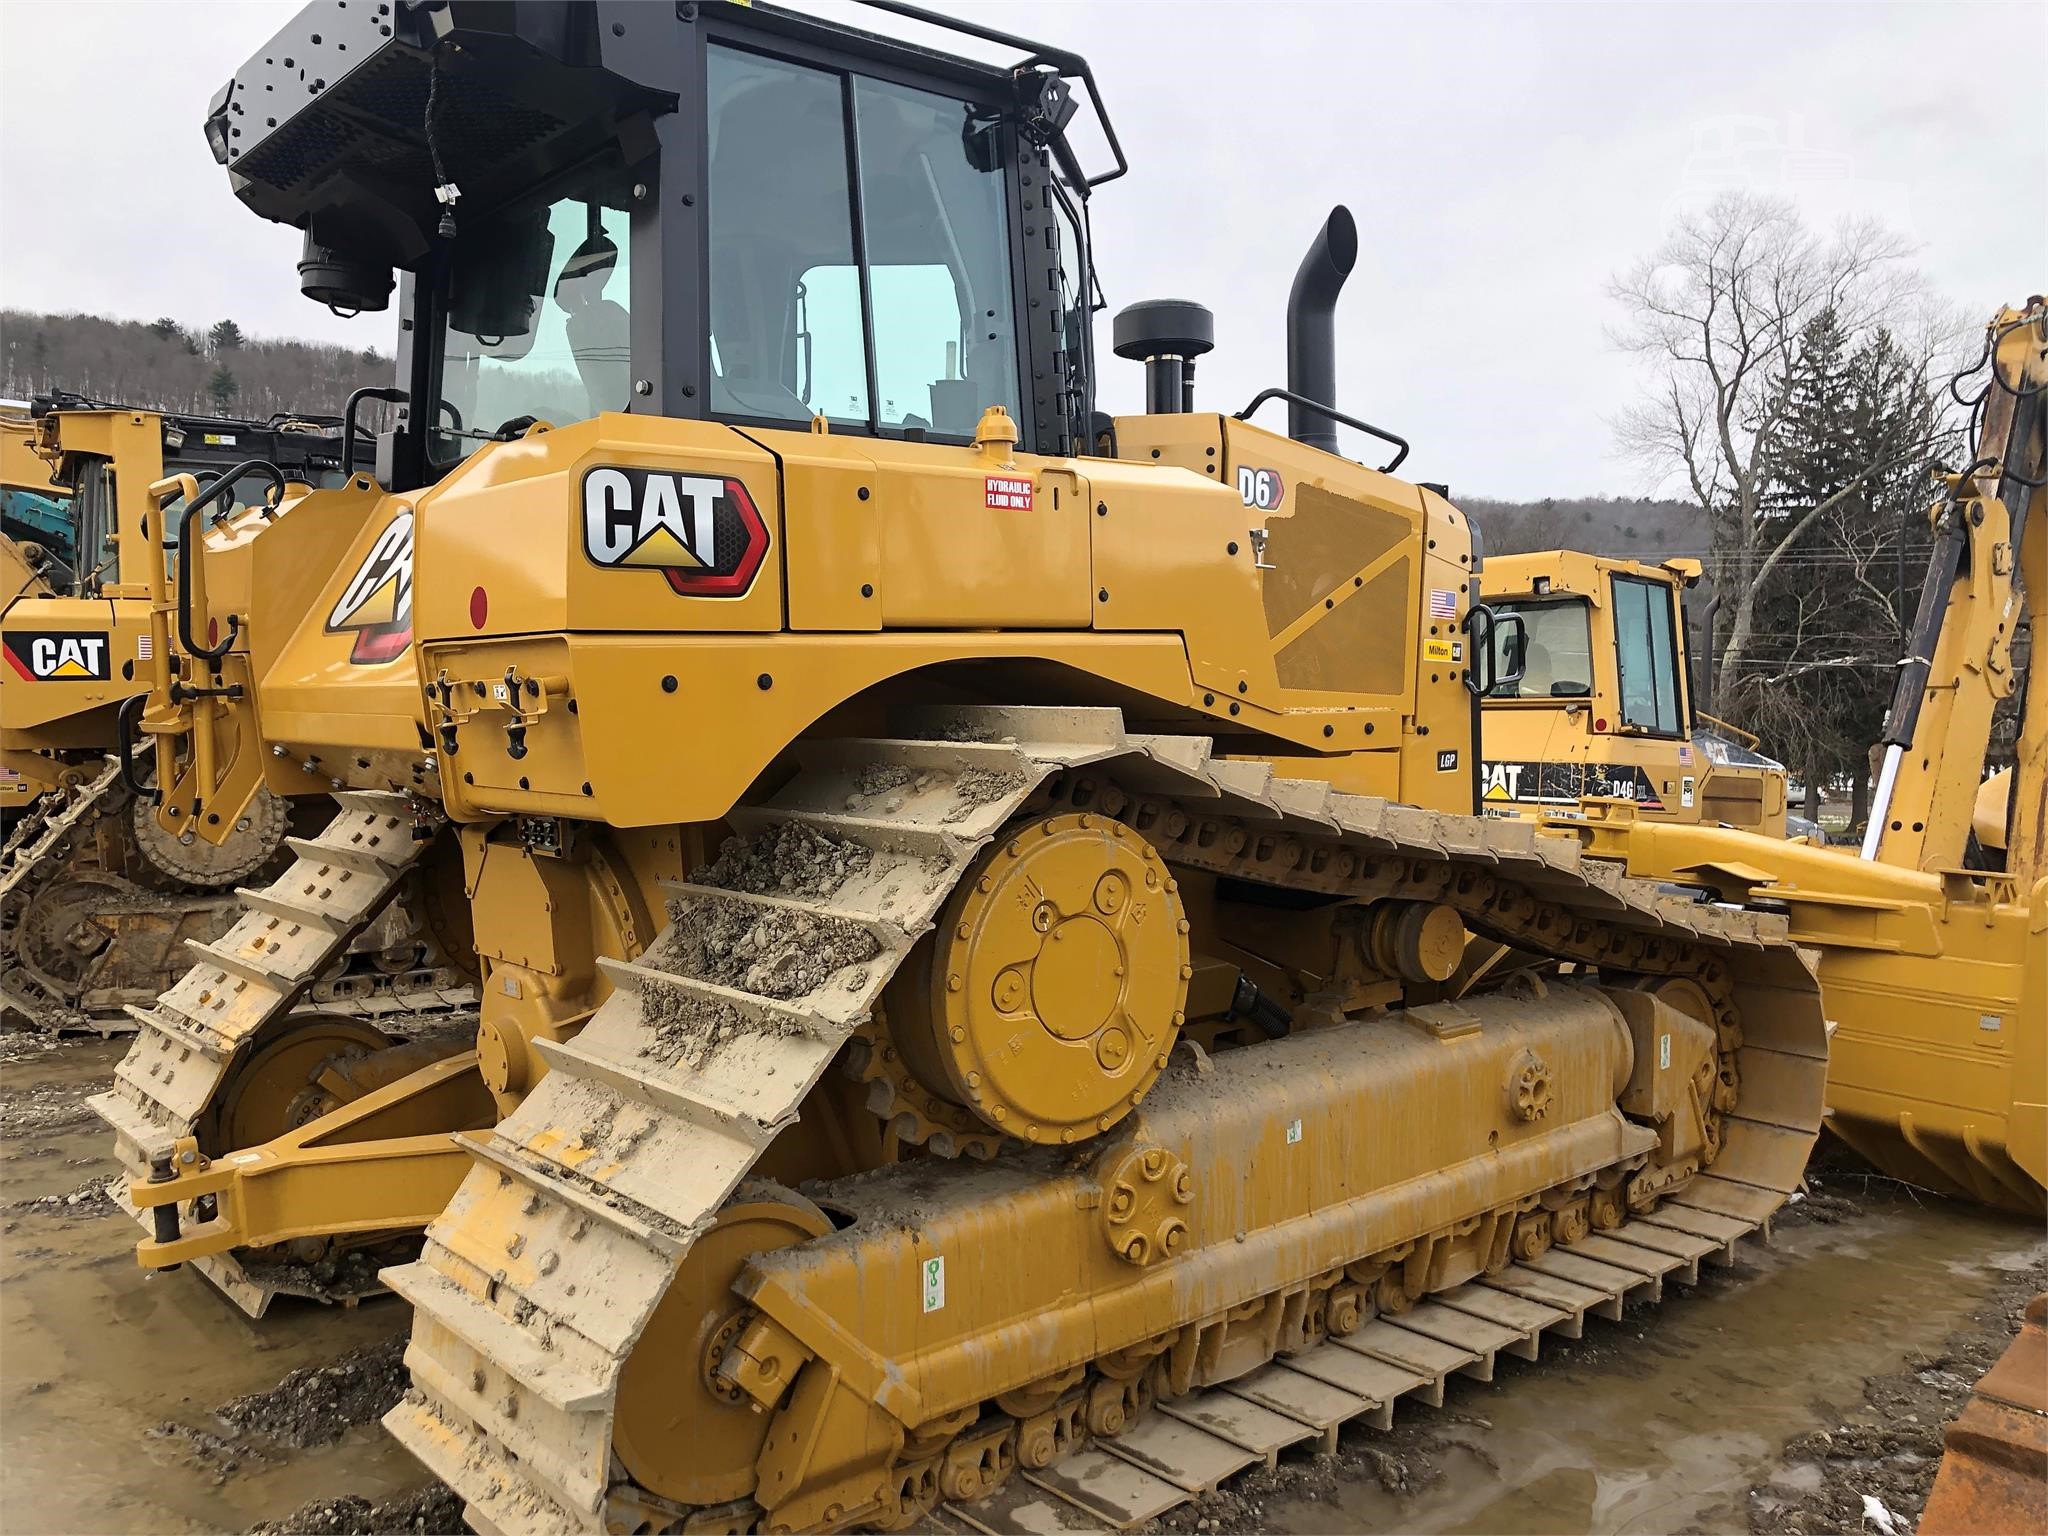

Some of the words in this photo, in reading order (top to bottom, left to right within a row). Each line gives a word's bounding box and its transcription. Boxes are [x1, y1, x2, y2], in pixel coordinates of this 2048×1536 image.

[987, 479, 1031, 494] HYDRAULIC
[1239, 467, 1270, 507] D6
[987, 493, 1009, 506] FLUID
[1010, 495, 1031, 508] ONLY
[585, 468, 724, 567] CAT
[32, 638, 103, 676] CAT
[1428, 645, 1448, 656] Milton
[1440, 753, 1455, 768] LGP
[1613, 780, 1634, 798] D4G
